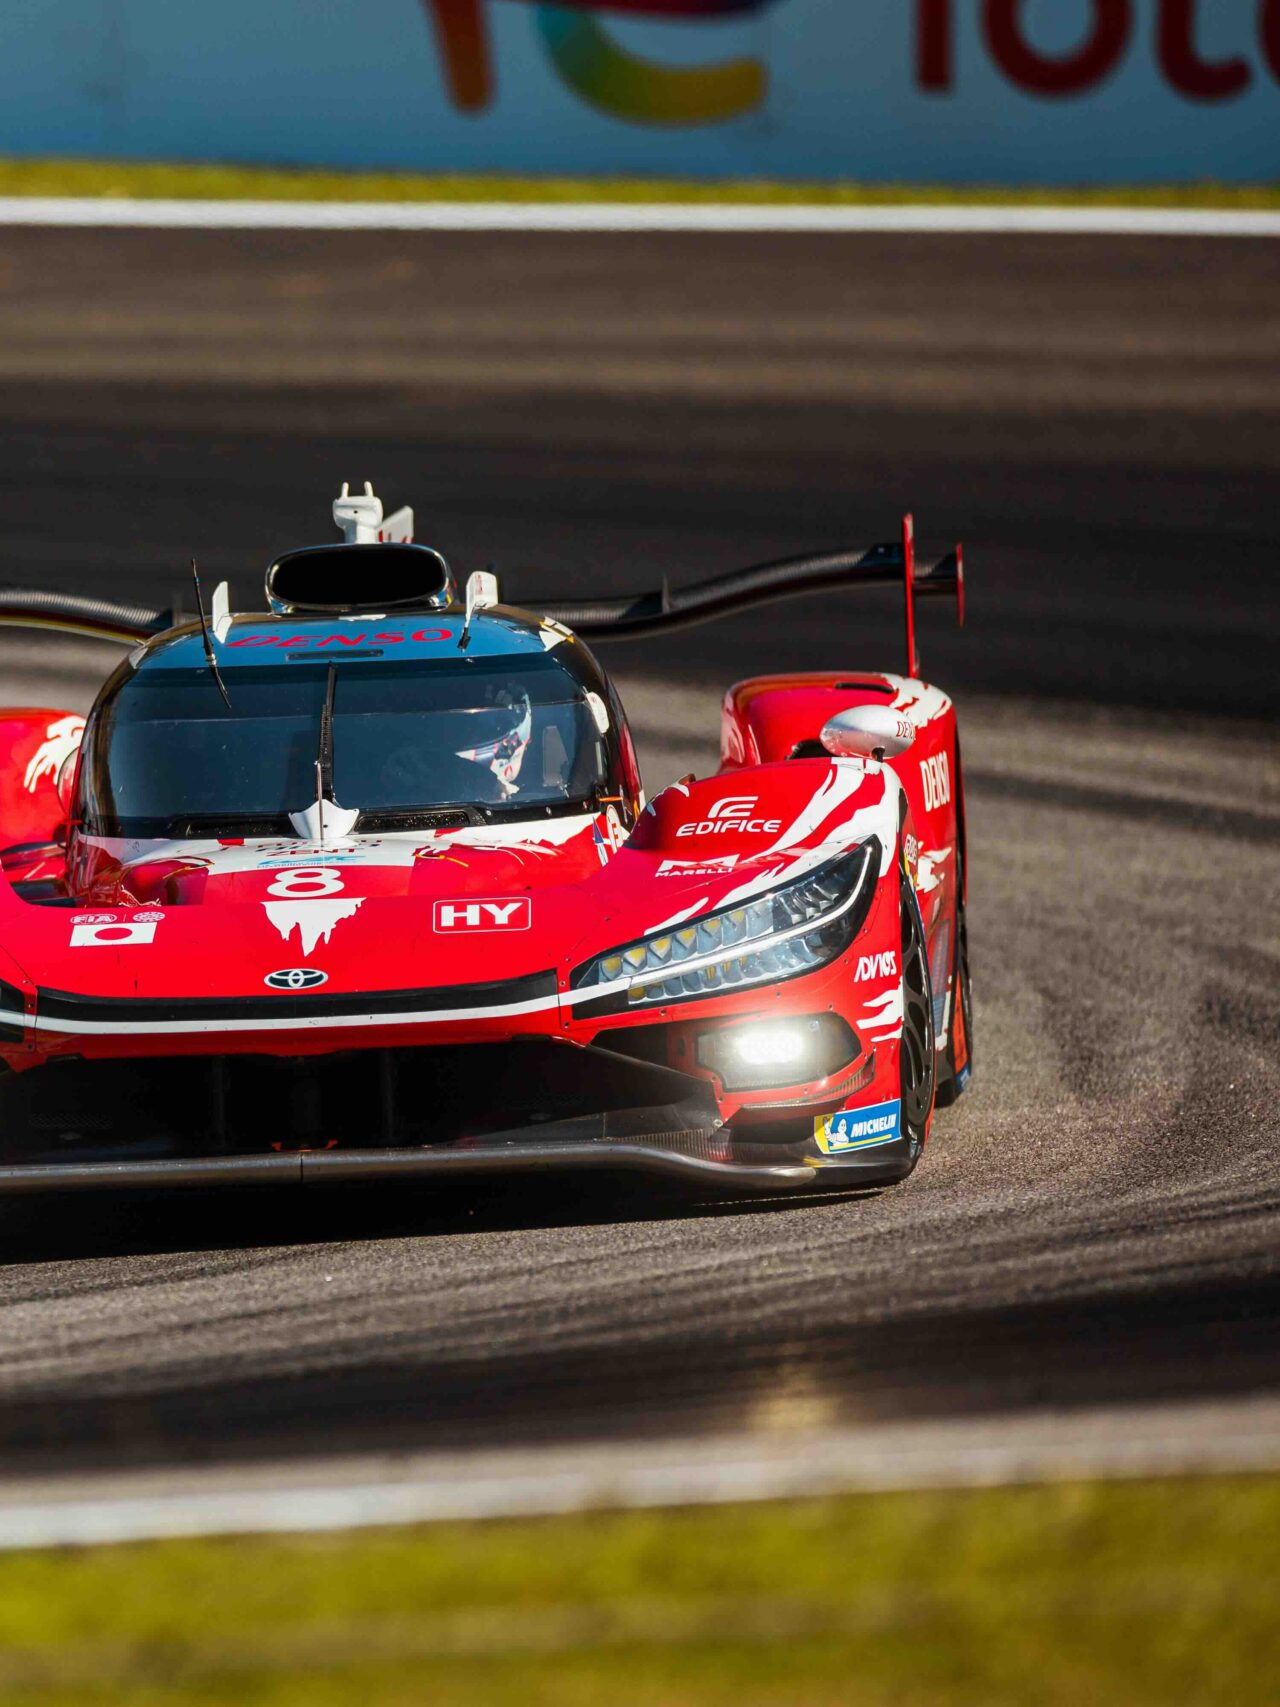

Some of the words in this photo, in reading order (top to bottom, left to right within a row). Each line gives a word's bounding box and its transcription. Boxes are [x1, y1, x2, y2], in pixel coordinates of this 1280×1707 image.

[224, 628, 453, 648] DENSO
[675, 819, 782, 837] EDIFICE
[266, 867, 345, 898] 8
[655, 867, 733, 877] MARELLI
[73, 914, 113, 923] FIA
[440, 902, 524, 927] HY
[853, 950, 897, 983] ADVICS
[850, 1113, 897, 1138] MICHELIN
